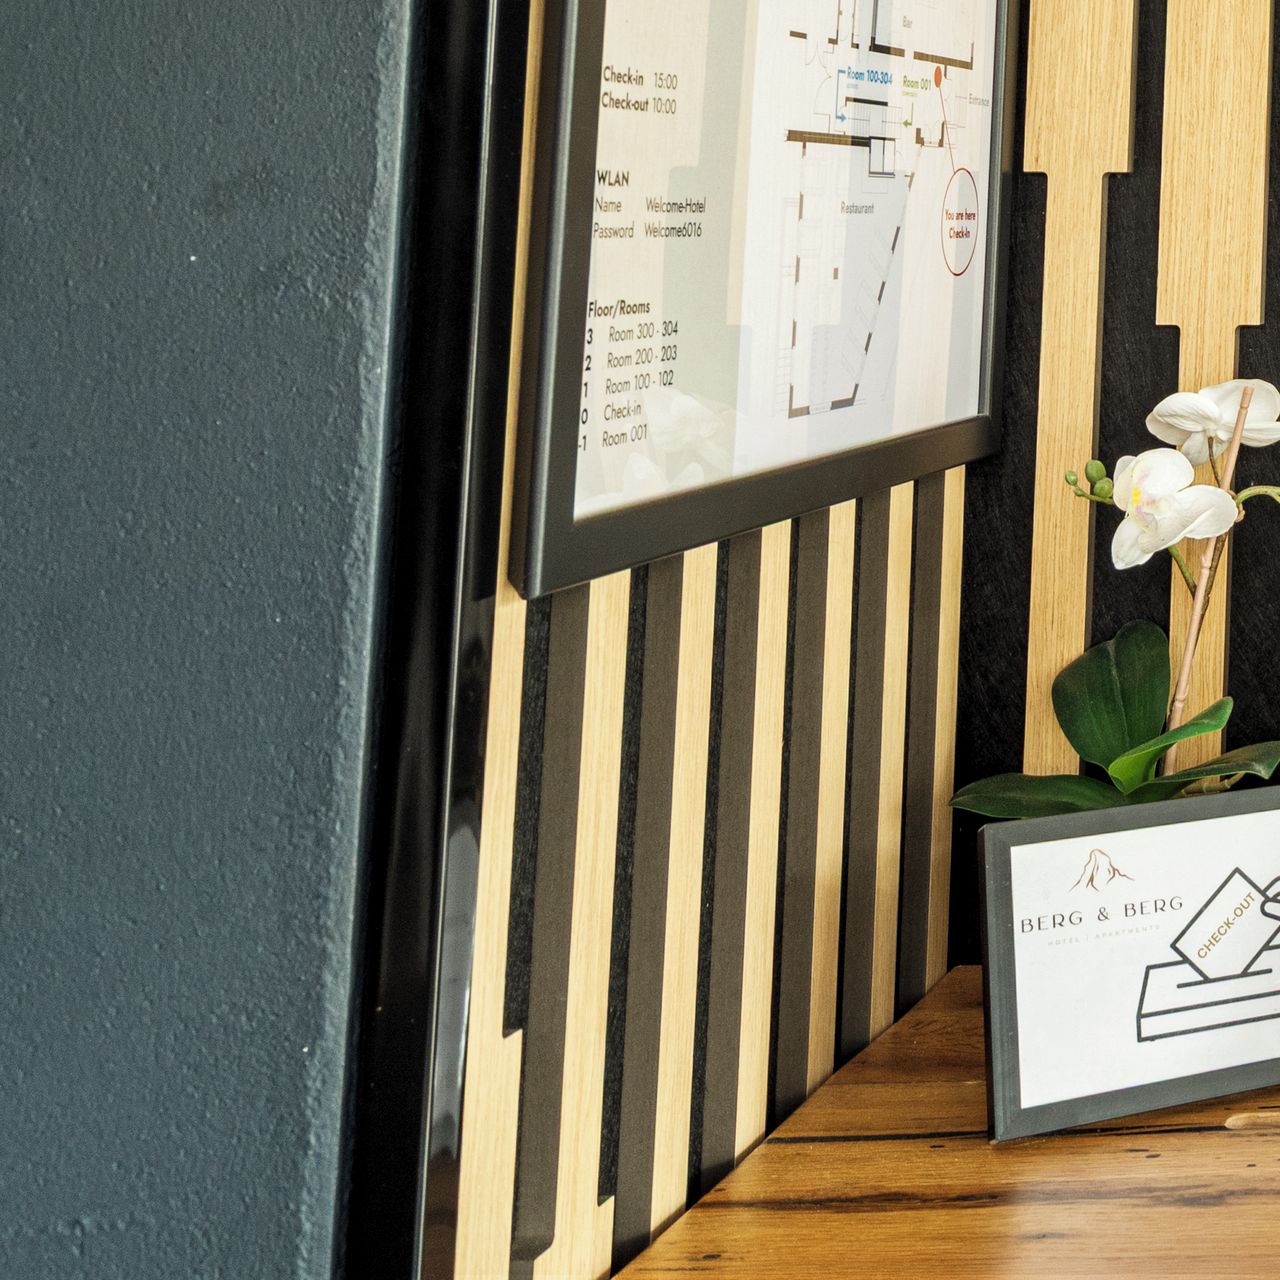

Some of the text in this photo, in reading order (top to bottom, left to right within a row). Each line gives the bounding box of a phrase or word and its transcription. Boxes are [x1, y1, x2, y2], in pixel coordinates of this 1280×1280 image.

[603, 65, 678, 90] Check-in 15:00
[847, 66, 865, 81] Room
[902, 75, 919, 90] Room
[601, 91, 677, 115] Check-out 10:00
[597, 170, 630, 187] WLAN
[595, 196, 706, 213] Name Welcome-Hotel
[841, 200, 875, 214] Restaurant
[945, 208, 976, 221] You are here
[593, 221, 703, 239] Password Welcome6016
[588, 299, 651, 319] Floor/Rooms
[586, 328, 594, 345] 3
[608, 325, 634, 343] Room
[636, 322, 655, 340] 300
[661, 320, 678, 337] 304
[584, 355, 592, 371] 2
[607, 351, 633, 369] Room
[635, 348, 653, 366] 200
[660, 344, 678, 362] 203
[583, 382, 588, 398] 1
[605, 378, 631, 395] Room
[634, 372, 650, 391] 100
[658, 369, 674, 387] 102
[603, 399, 642, 421] Check-in
[602, 430, 628, 447] Room
[630, 424, 648, 442] 001
[1020, 896, 1184, 934] BERG & BERG
[1197, 891, 1257, 960] CHECK-OUT
